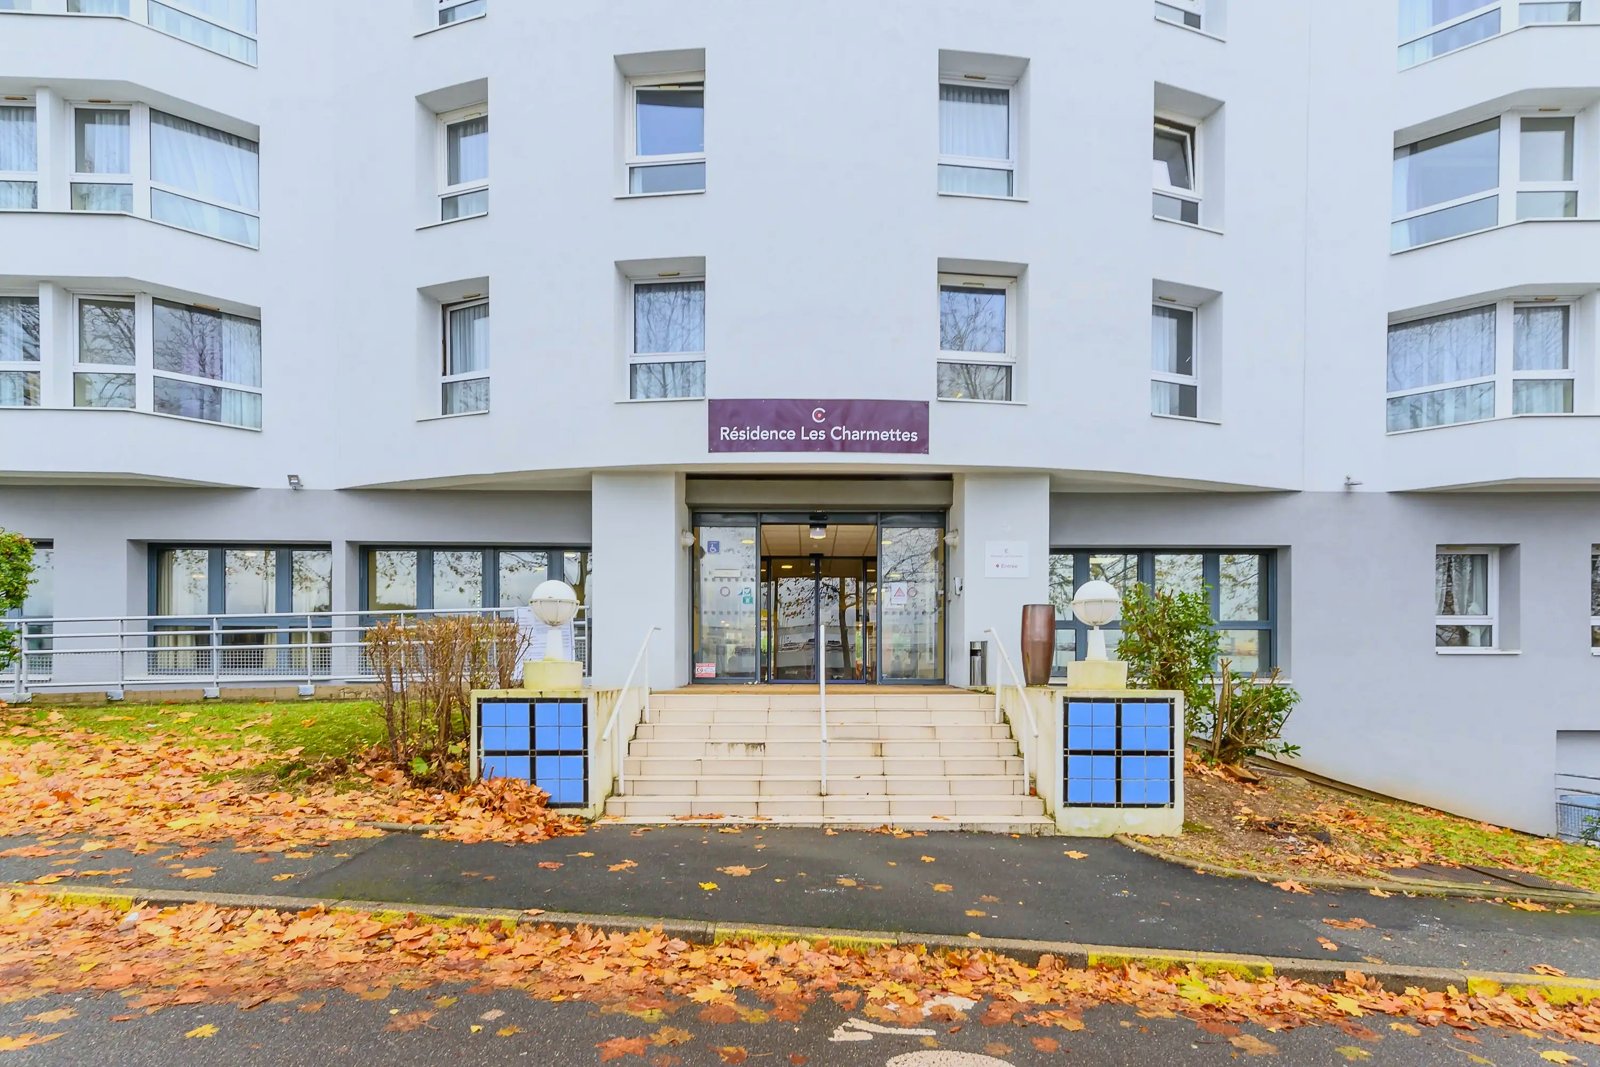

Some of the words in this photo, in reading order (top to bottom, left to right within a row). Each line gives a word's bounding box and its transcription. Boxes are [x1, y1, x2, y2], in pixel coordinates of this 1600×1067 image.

[719, 425, 796, 441] Résidence
[801, 426, 826, 441] Les
[830, 425, 918, 442] Charmettes
